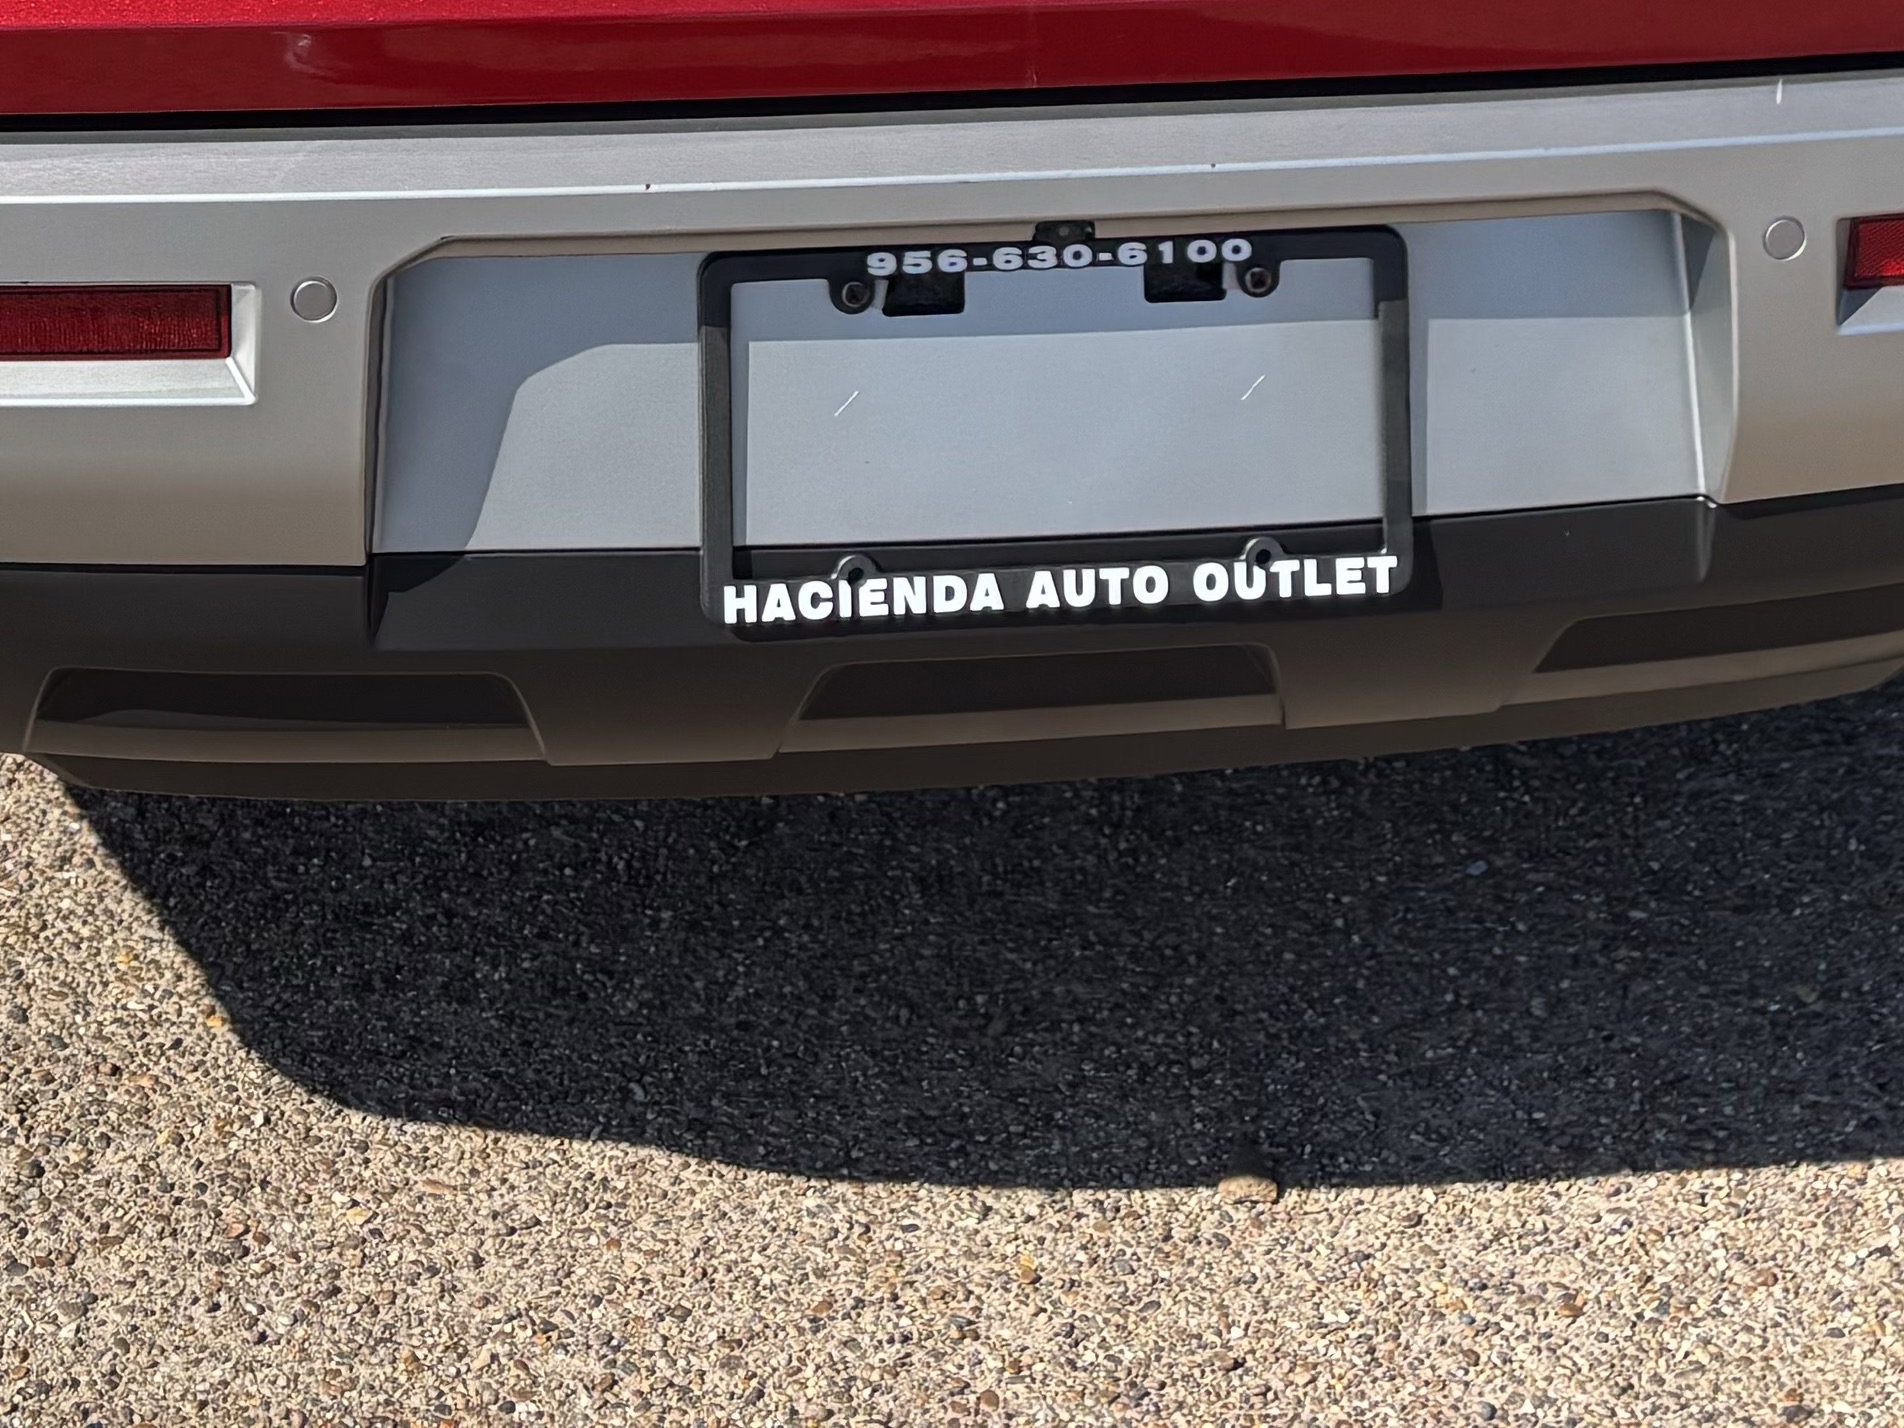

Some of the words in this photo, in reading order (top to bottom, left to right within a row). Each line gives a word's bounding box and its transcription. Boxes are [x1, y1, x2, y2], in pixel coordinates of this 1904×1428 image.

[865, 237, 1254, 278] 956-630-6100
[722, 574, 1005, 626] HACIENDA
[1024, 563, 1171, 612] AUTO
[1193, 554, 1400, 604] OUTLET
